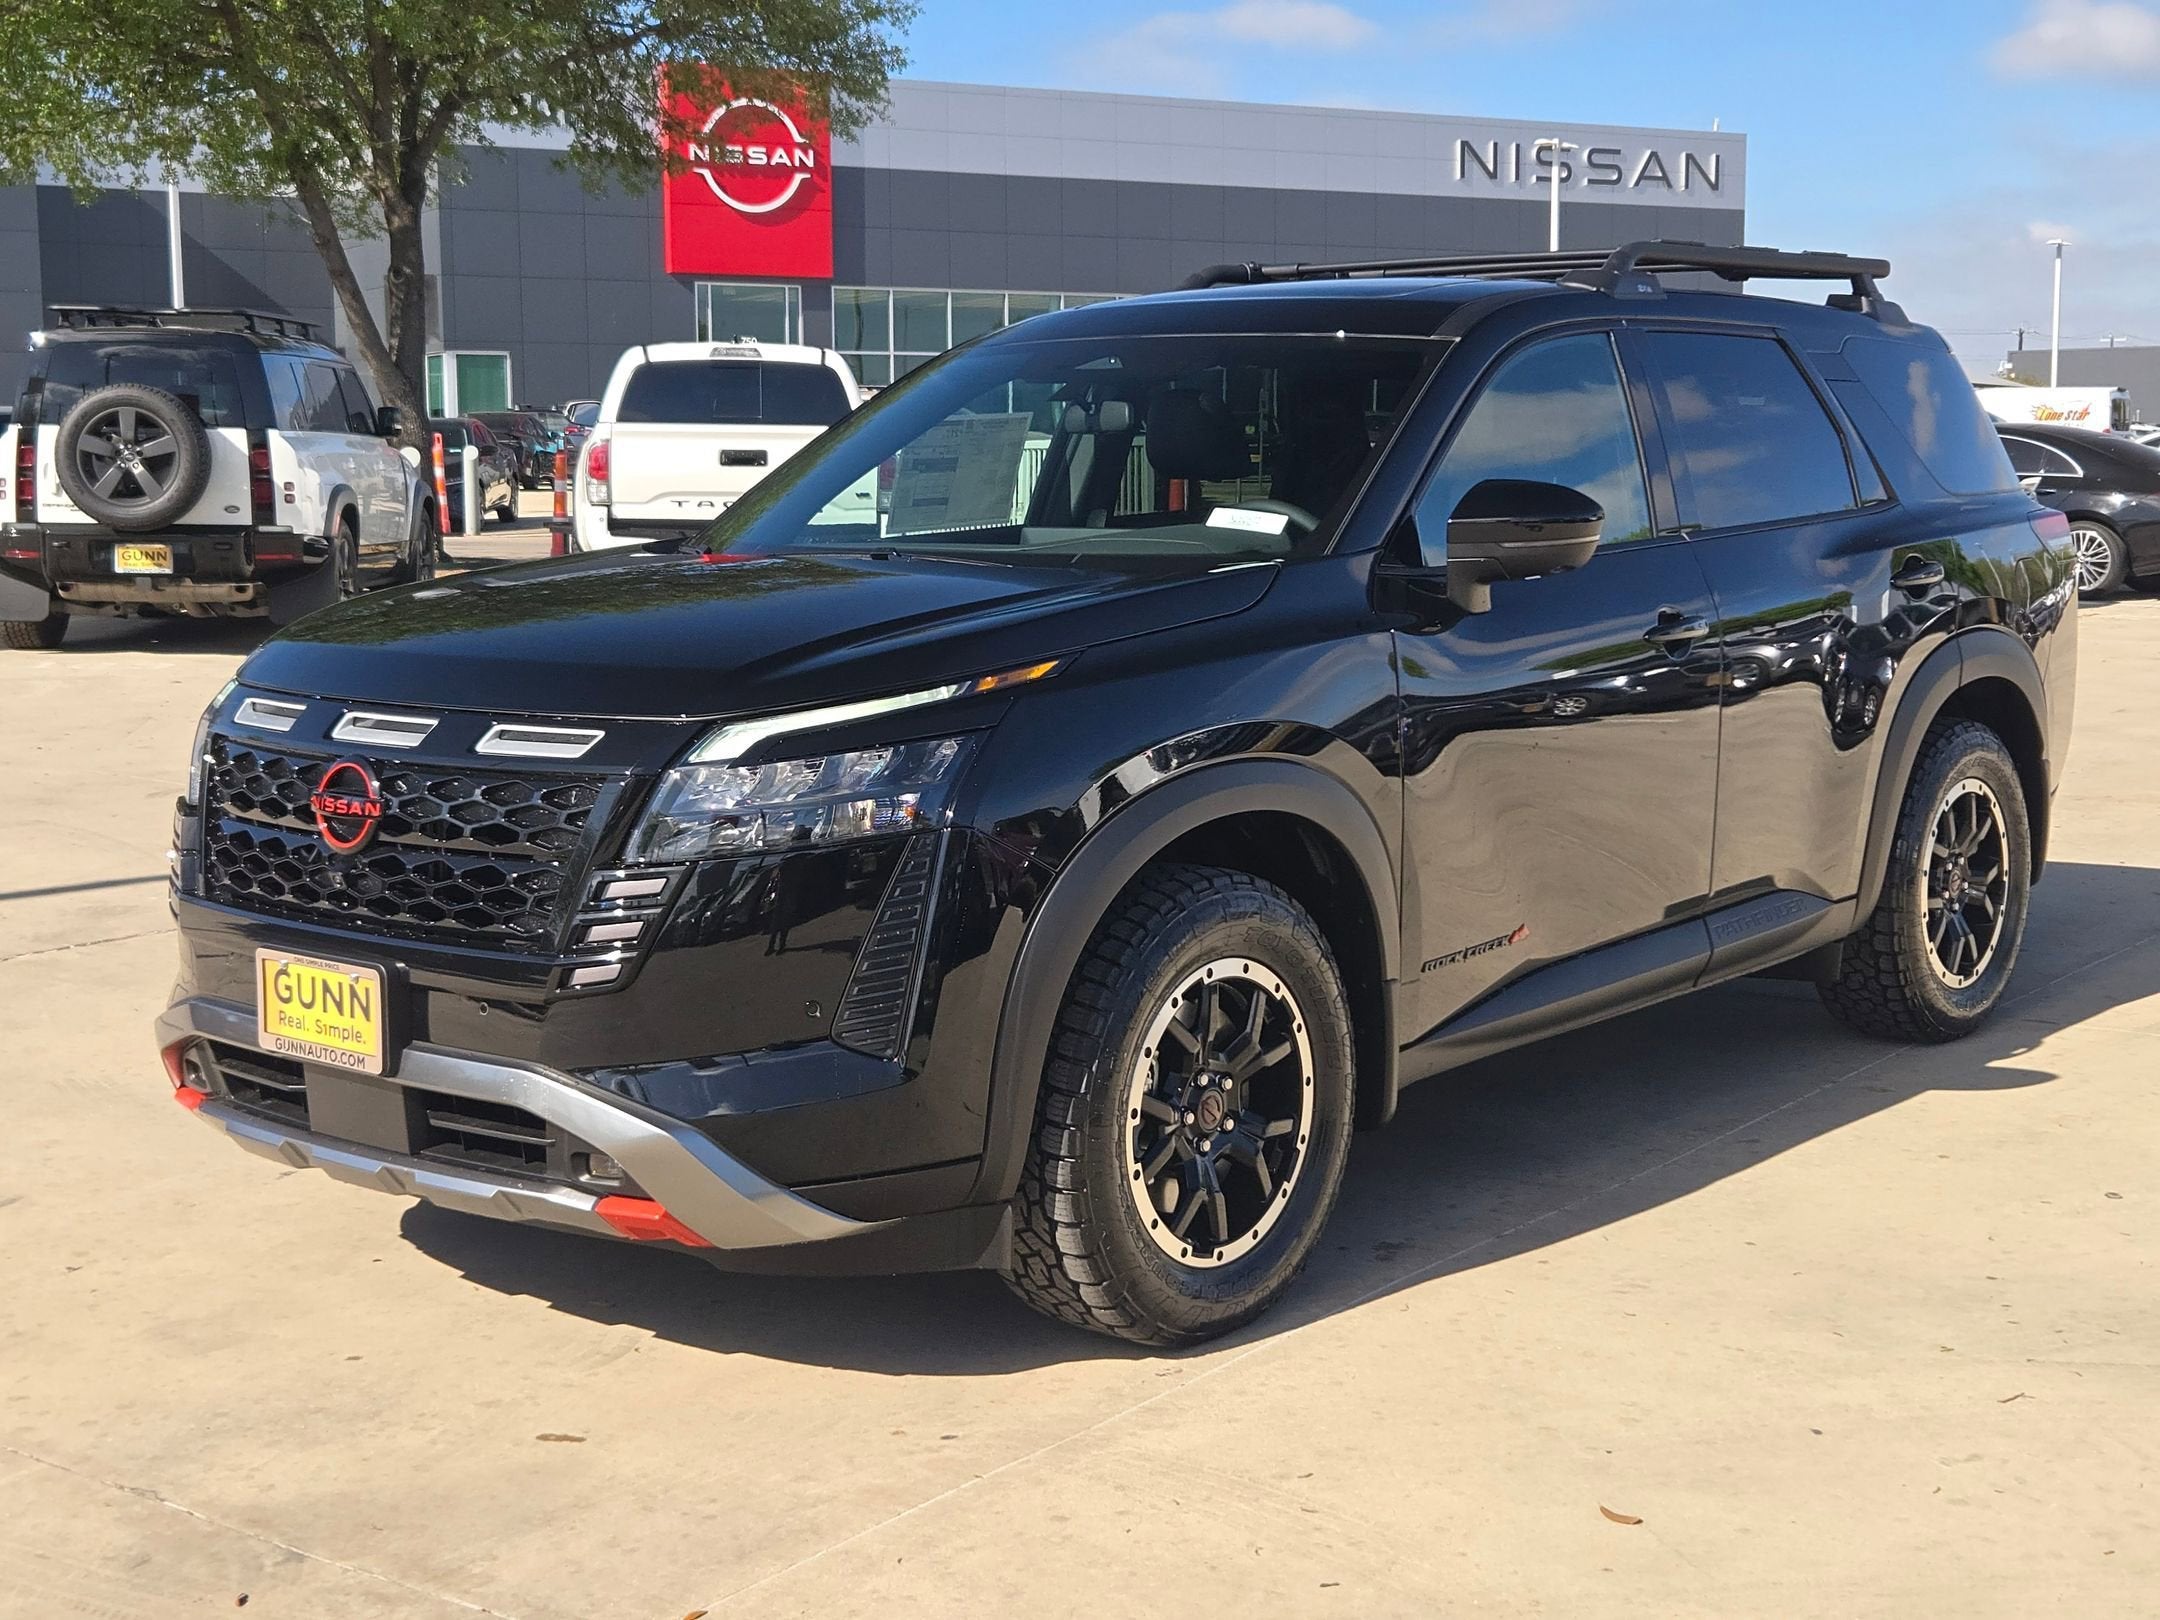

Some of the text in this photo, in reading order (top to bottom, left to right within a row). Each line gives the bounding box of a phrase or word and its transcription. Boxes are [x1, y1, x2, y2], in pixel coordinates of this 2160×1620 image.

[1456, 138, 1721, 192] NISSAN
[121, 550, 168, 562] GUNN
[310, 795, 382, 817] NISSAN
[273, 967, 372, 1023] GUNN
[278, 1010, 310, 1032] Real.
[275, 1037, 366, 1070] GUNNAUTO.COM
